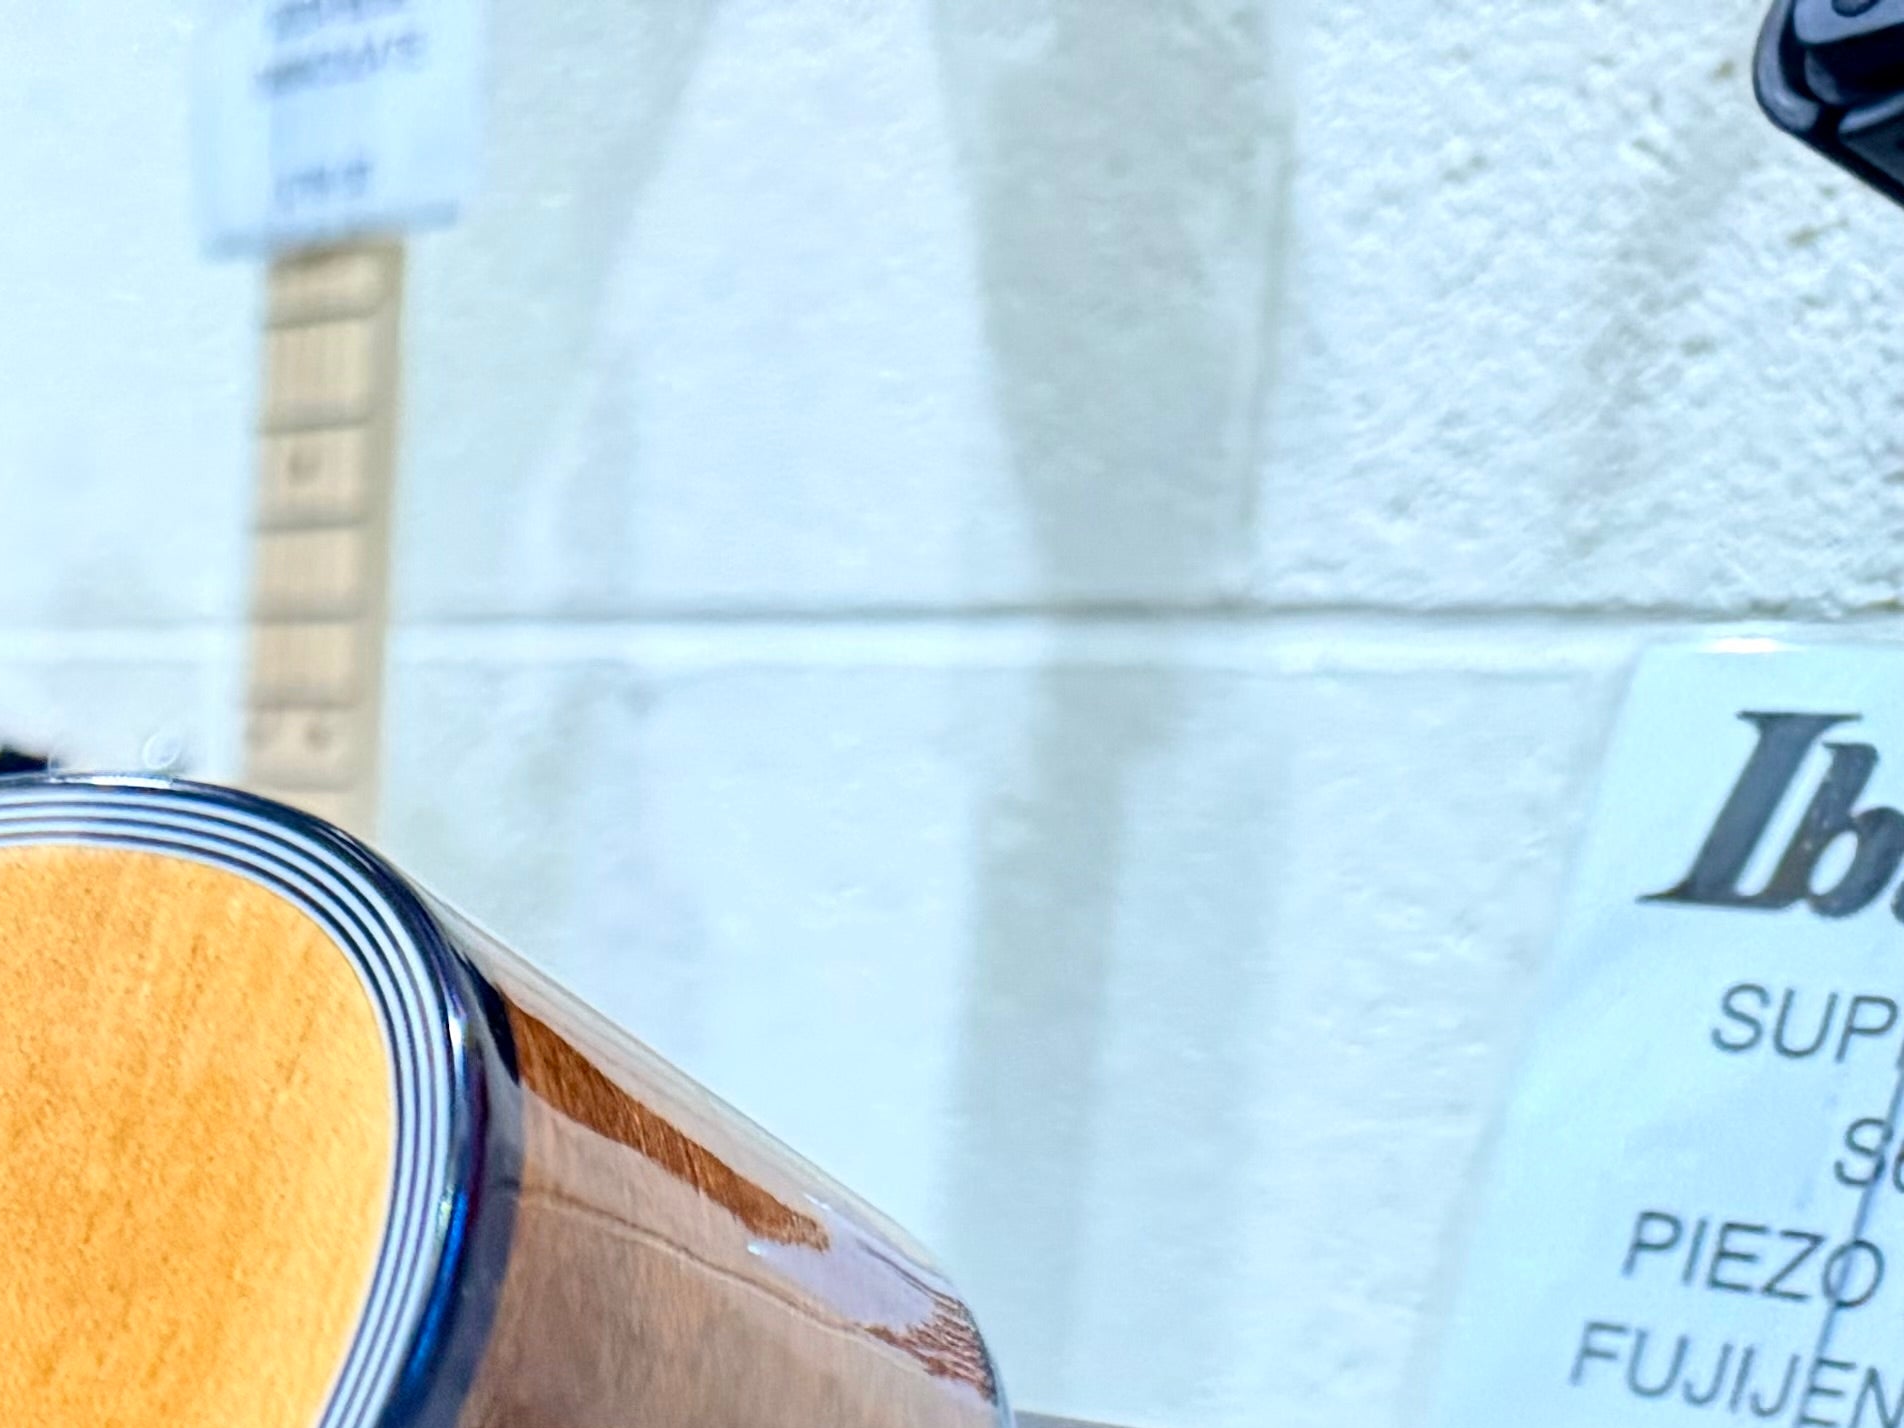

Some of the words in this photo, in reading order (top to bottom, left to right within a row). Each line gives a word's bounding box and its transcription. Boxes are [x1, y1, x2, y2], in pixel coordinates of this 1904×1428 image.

[1636, 710, 1904, 922] Ib
[1711, 982, 1904, 1068] SUP
[1621, 1209, 1886, 1309] PIEZO
